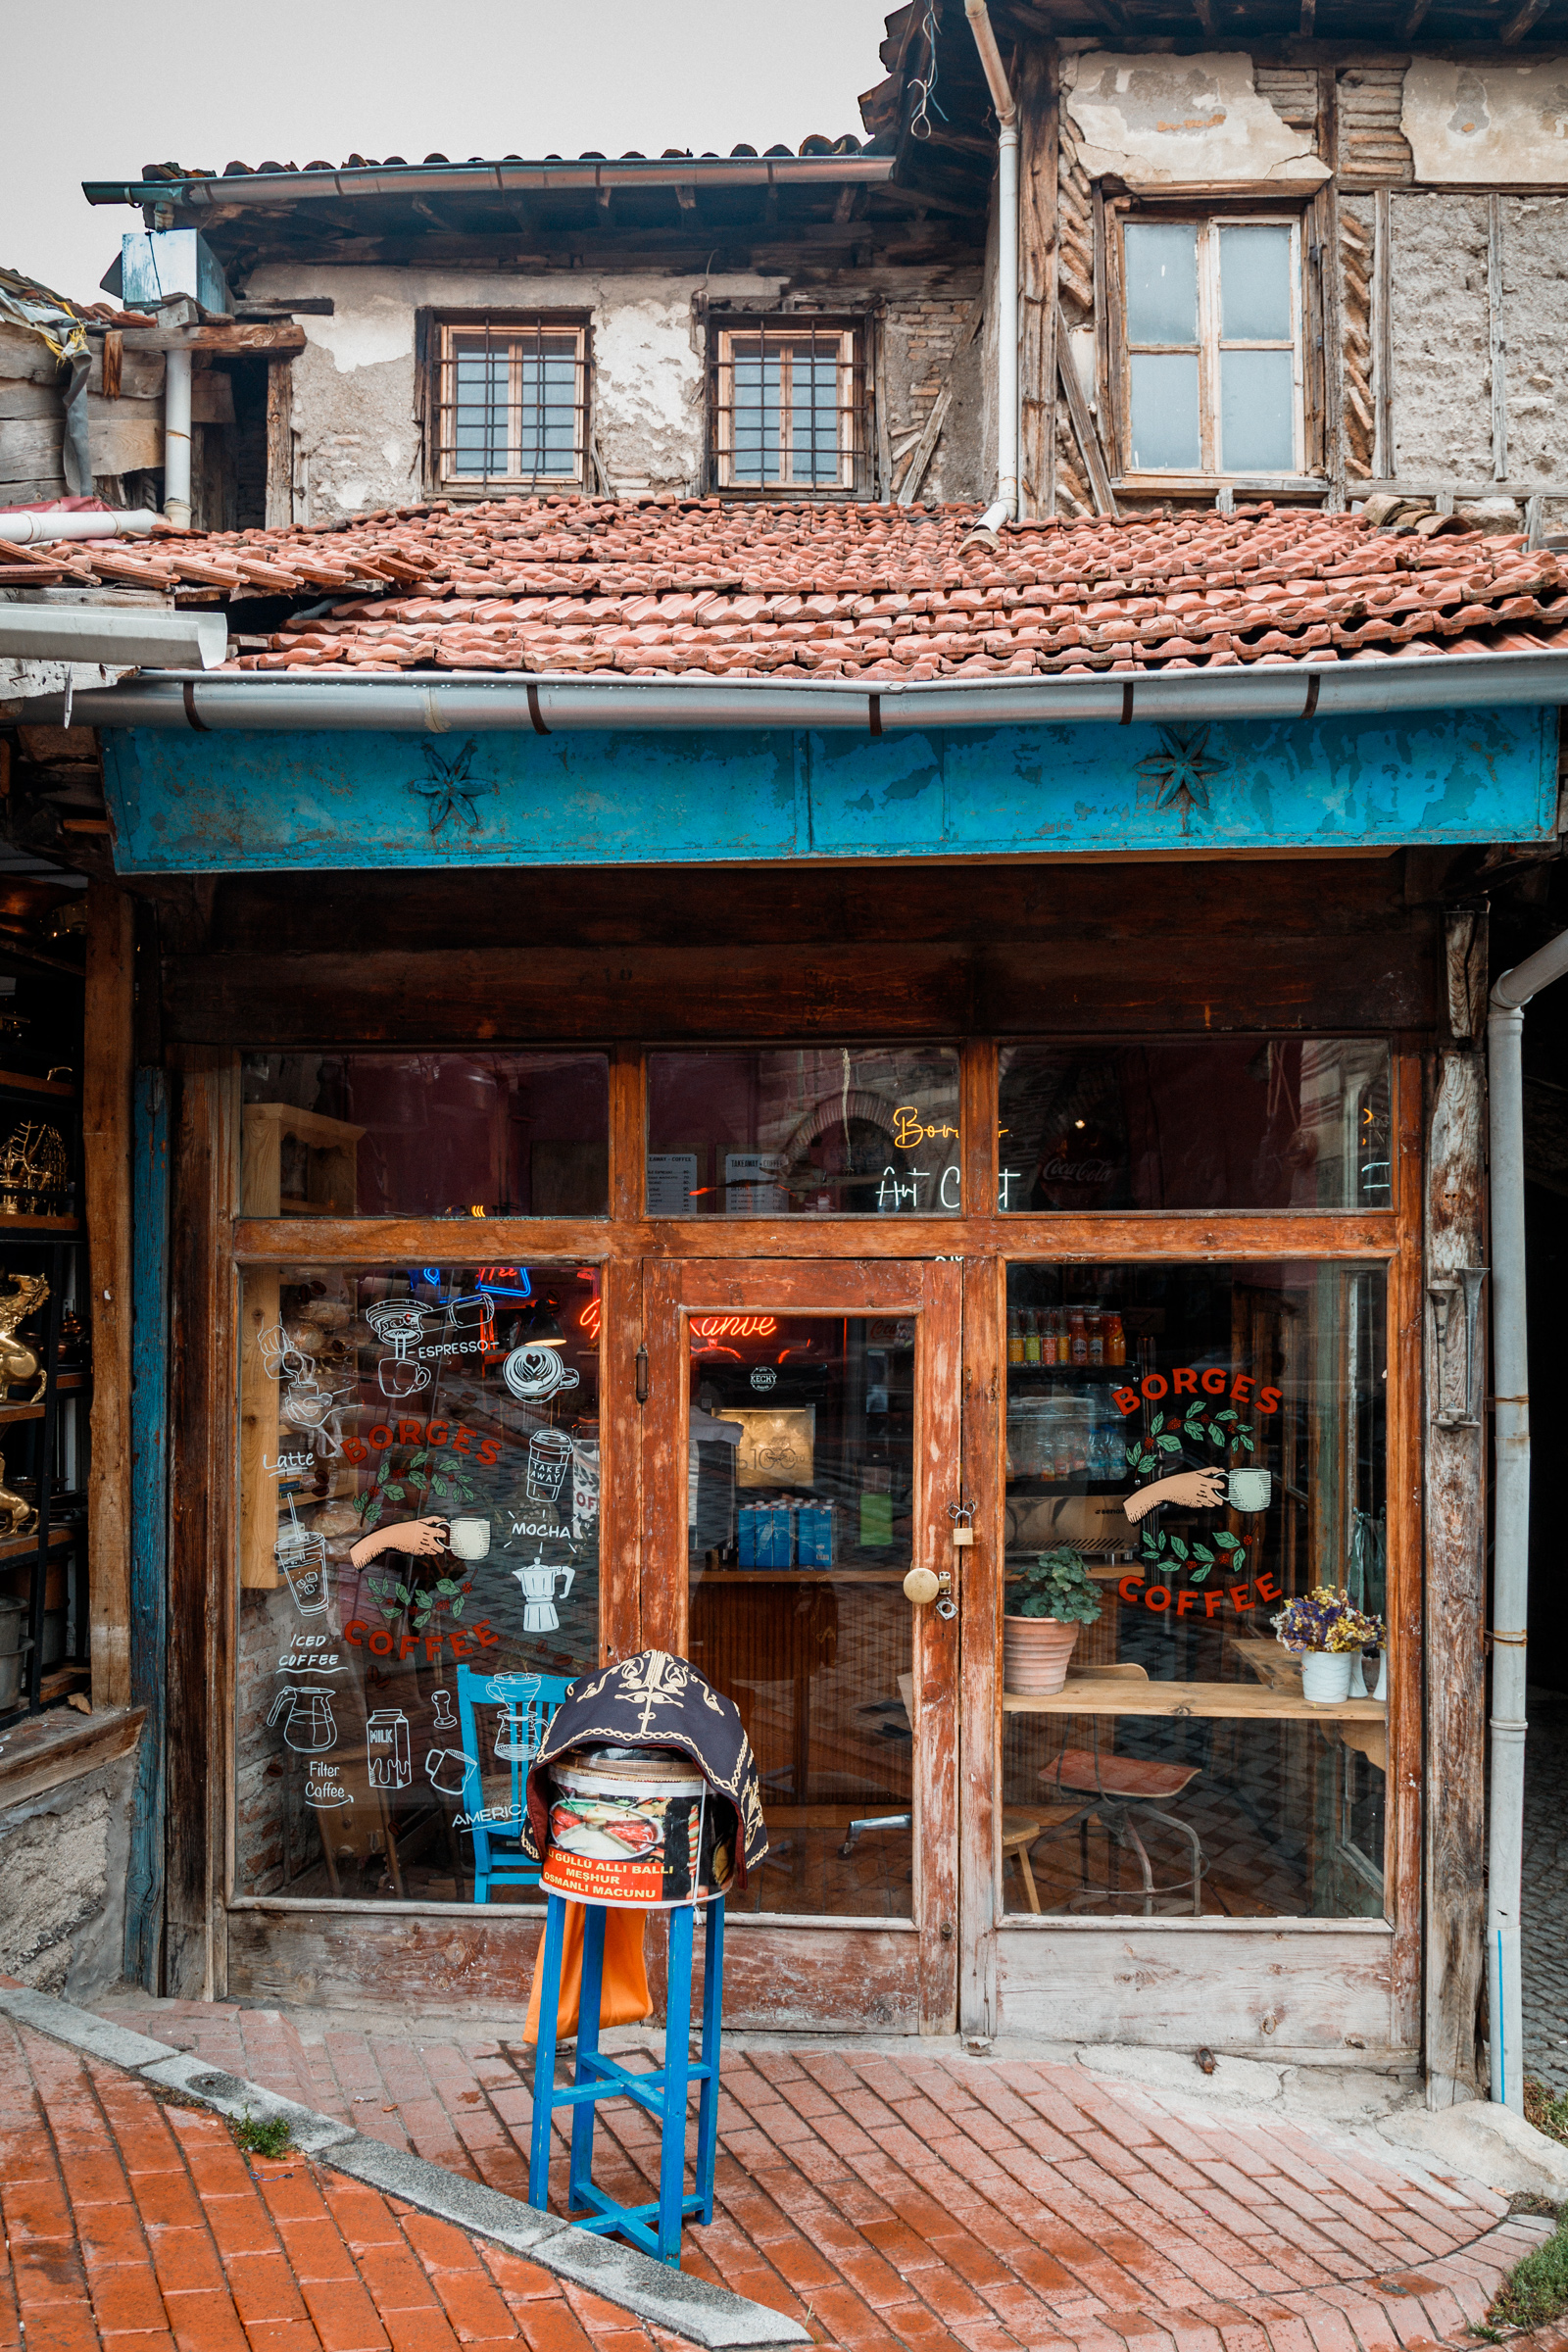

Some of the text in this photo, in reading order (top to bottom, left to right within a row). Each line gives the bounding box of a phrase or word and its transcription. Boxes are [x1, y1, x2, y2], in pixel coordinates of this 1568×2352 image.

[1110, 1367, 1284, 1417] BORGES
[339, 1419, 503, 1467] BORGES
[263, 1450, 316, 1470] Latte
[532, 1460, 562, 1474] TAKE
[530, 1470, 562, 1484] AWAY
[512, 1522, 571, 1540] MOCHA
[1118, 1571, 1283, 1618] COFFEE
[290, 1634, 326, 1647] ICED
[343, 1618, 500, 1662] COFFEE
[277, 1653, 340, 1668] COFFEE
[369, 1729, 393, 1743] MILK
[309, 1760, 340, 1778] Filter
[305, 1781, 346, 1799] Coffee
[555, 1852, 592, 1869] GÜLLÜ
[596, 1862, 627, 1874] ALLI
[631, 1865, 674, 1875] BALLI
[544, 1871, 656, 1898] OSMANLI MACUNU
[565, 1867, 620, 1885] MEŞHUR
